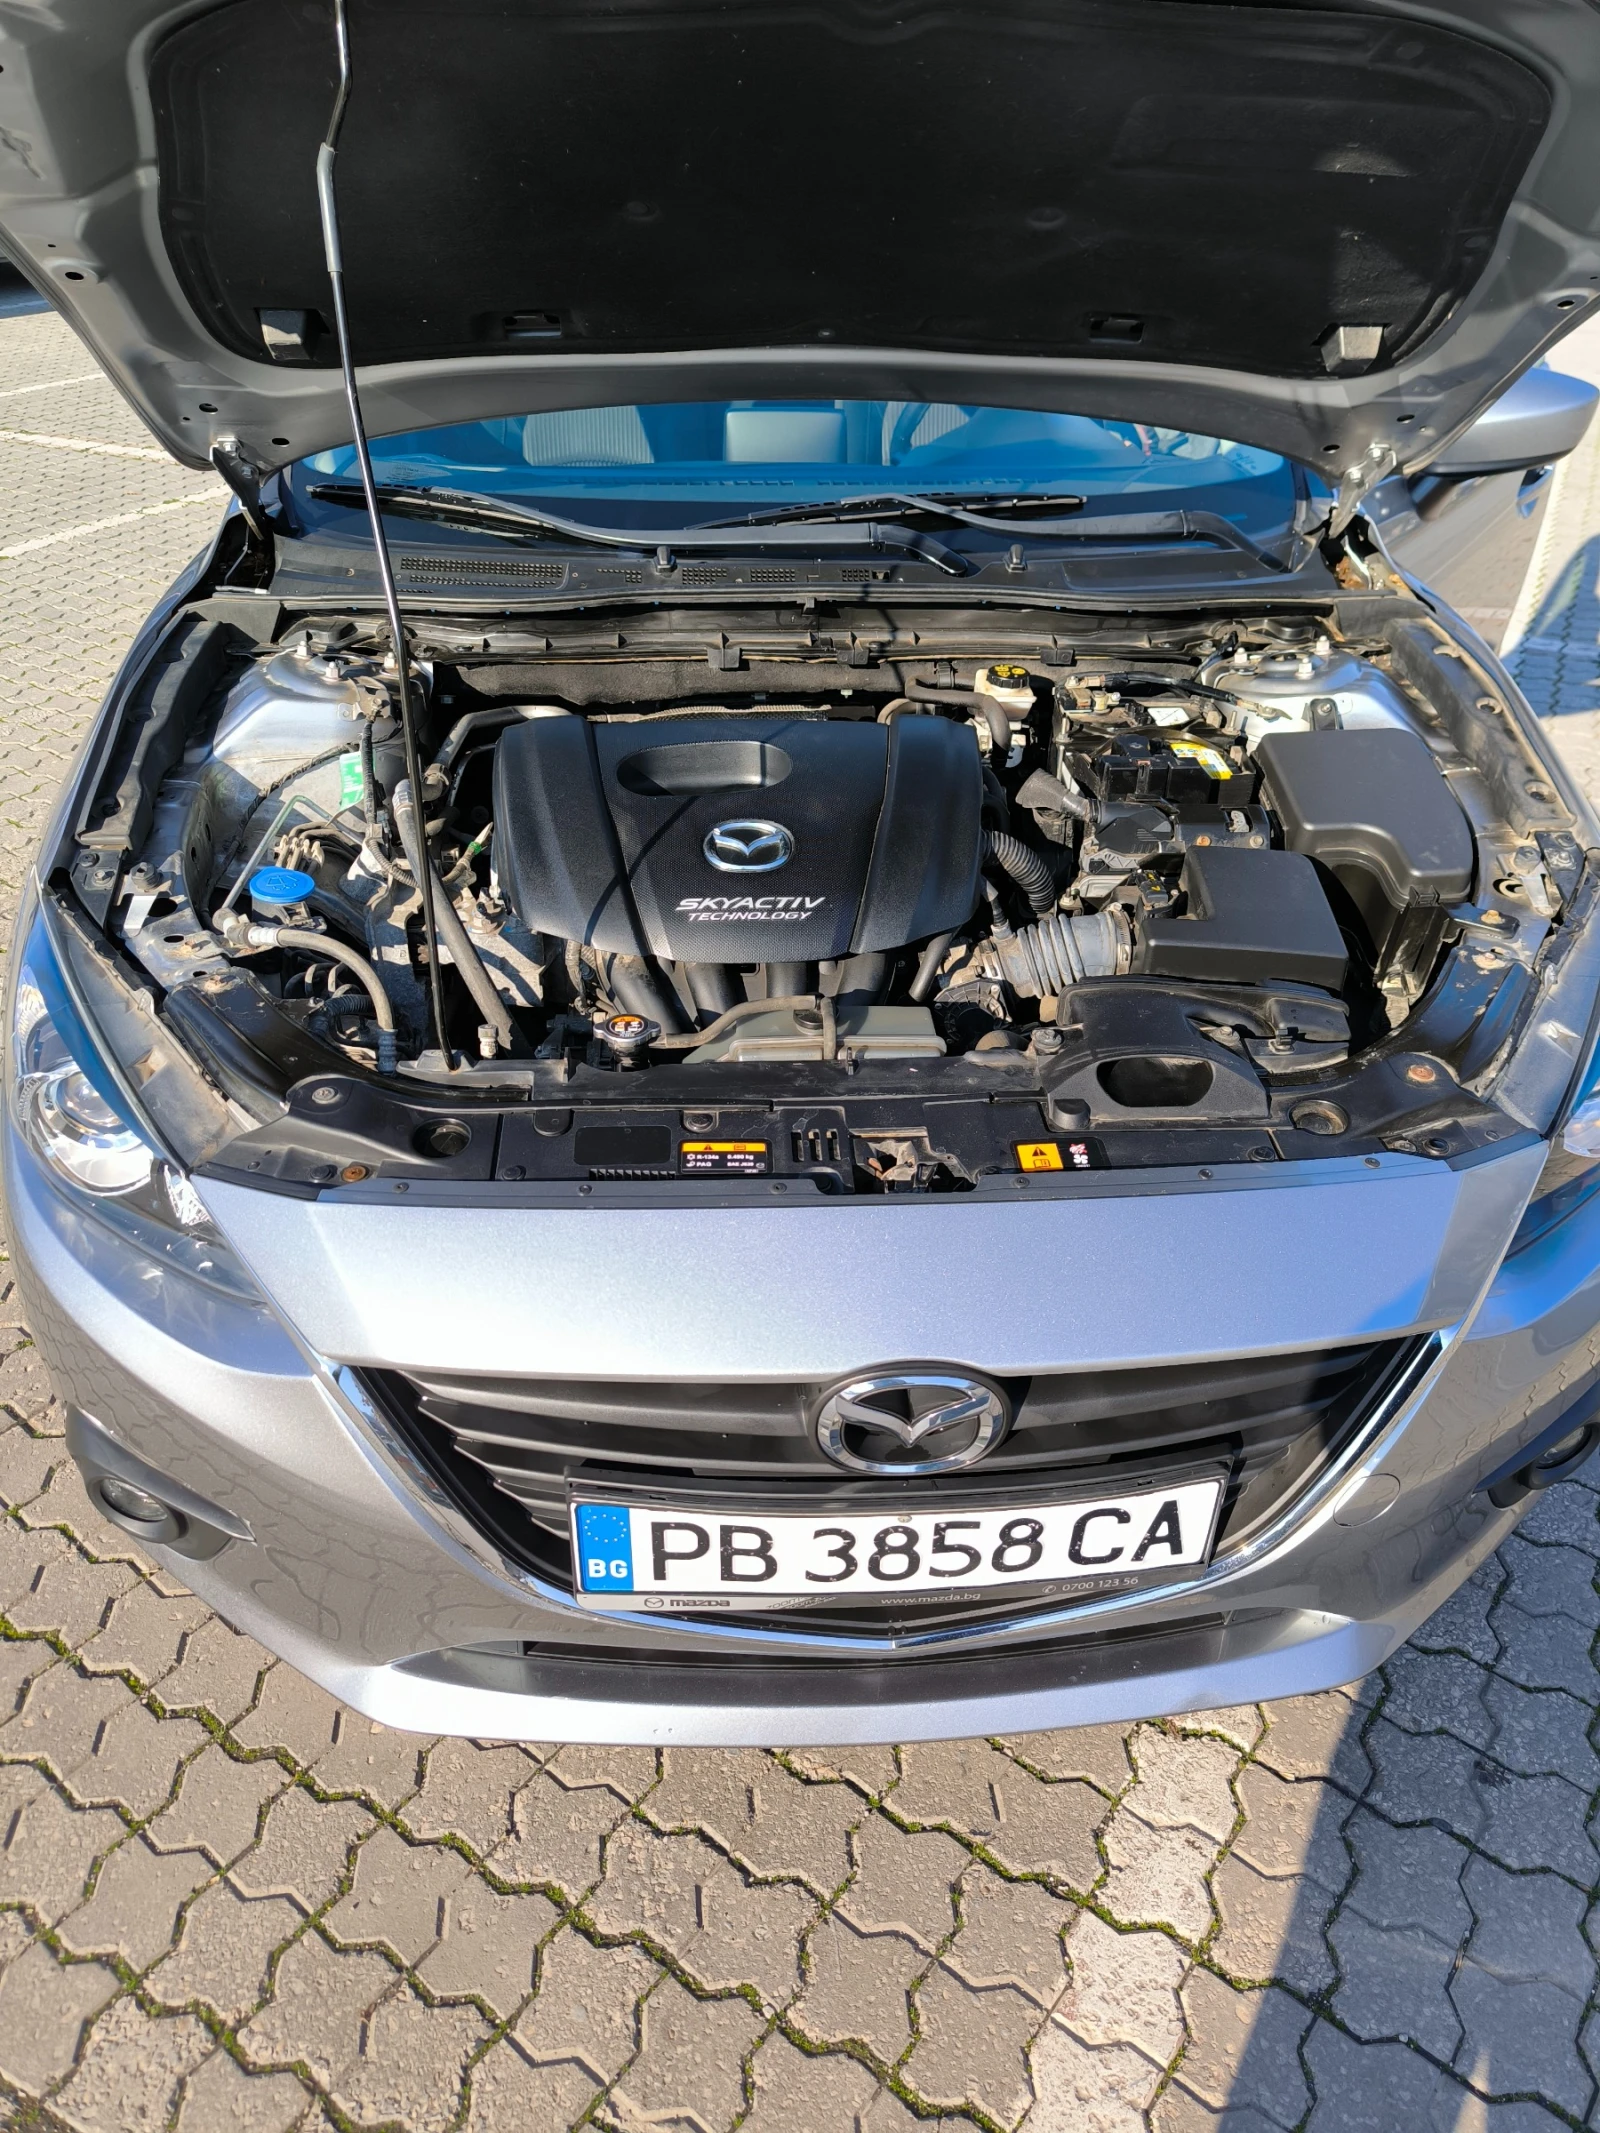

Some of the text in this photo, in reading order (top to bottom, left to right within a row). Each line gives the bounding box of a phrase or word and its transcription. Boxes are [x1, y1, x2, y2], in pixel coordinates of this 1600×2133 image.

[675, 896, 826, 911] SKYACTIV
[688, 911, 812, 922] TECHNOLOGY
[651, 1500, 1183, 1583] PB 3858 CA
[588, 1558, 628, 1578] BG
[1062, 1576, 1139, 1591] 0700 123 56
[670, 1599, 730, 1607] mazda
[881, 1592, 981, 1604] www.mazda.bg
